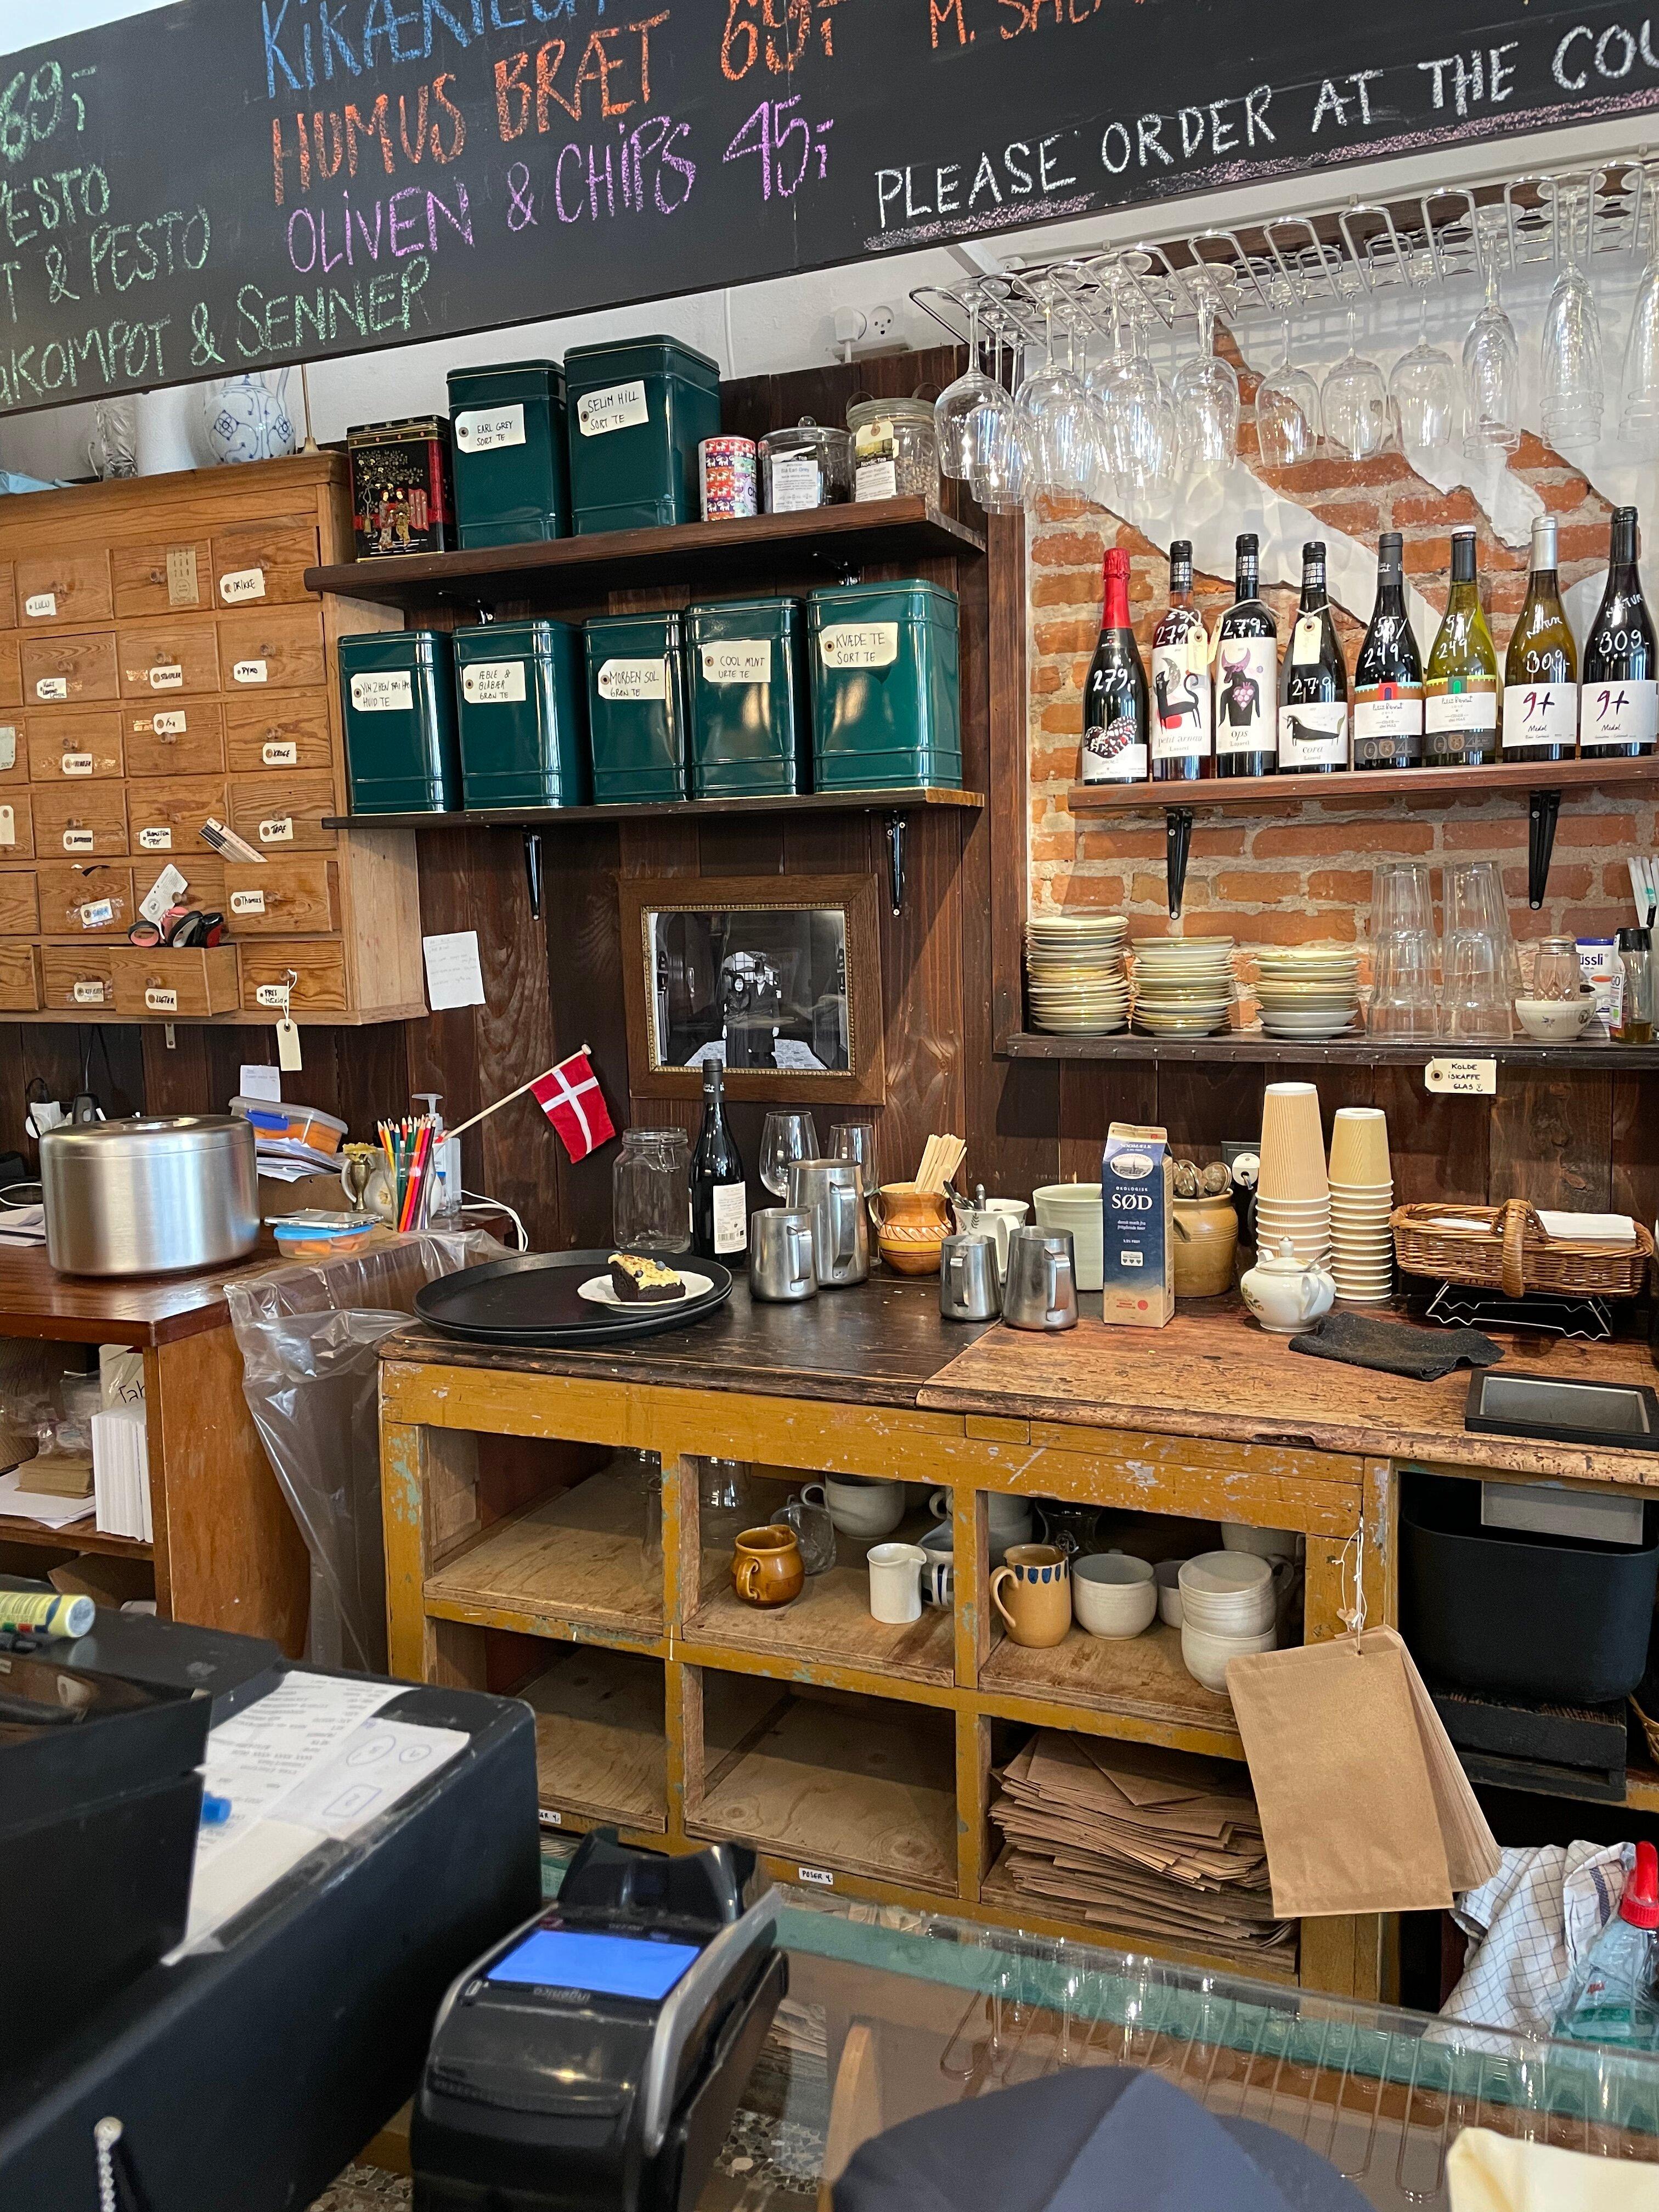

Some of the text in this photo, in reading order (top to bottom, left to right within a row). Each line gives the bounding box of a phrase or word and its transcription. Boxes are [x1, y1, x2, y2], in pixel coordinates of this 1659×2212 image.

[272, 73, 465, 206] HUMUS
[495, 10, 670, 142] BRÆT
[875, 133, 1076, 228] PLEASE
[1101, 84, 1276, 174] ORDER
[1312, 69, 1383, 133] AT
[1418, 42, 1519, 117] THE
[0, 163, 109, 246] ESTO
[507, 162, 538, 232] &
[44, 244, 80, 303] &
[91, 205, 210, 294] PESTO
[191, 302, 225, 366] &
[236, 256, 430, 357] SENNEP
[477, 421, 513, 434] EARL GREY
[590, 414, 625, 431] SORT TE
[477, 437, 492, 446] SORT
[836, 632, 885, 648] KVÆDE TE
[720, 656, 765, 667] COOL MINT
[837, 651, 876, 665] SORT TE
[479, 670, 498, 680] ÆBLE
[610, 670, 659, 686] MORGEN SOL
[718, 670, 750, 678] URTE TE
[631, 689, 641, 697] TE
[379, 697, 390, 707] TE
[1111, 1193, 1153, 1210] SØD
[802, 1870, 822, 1880] POSER
